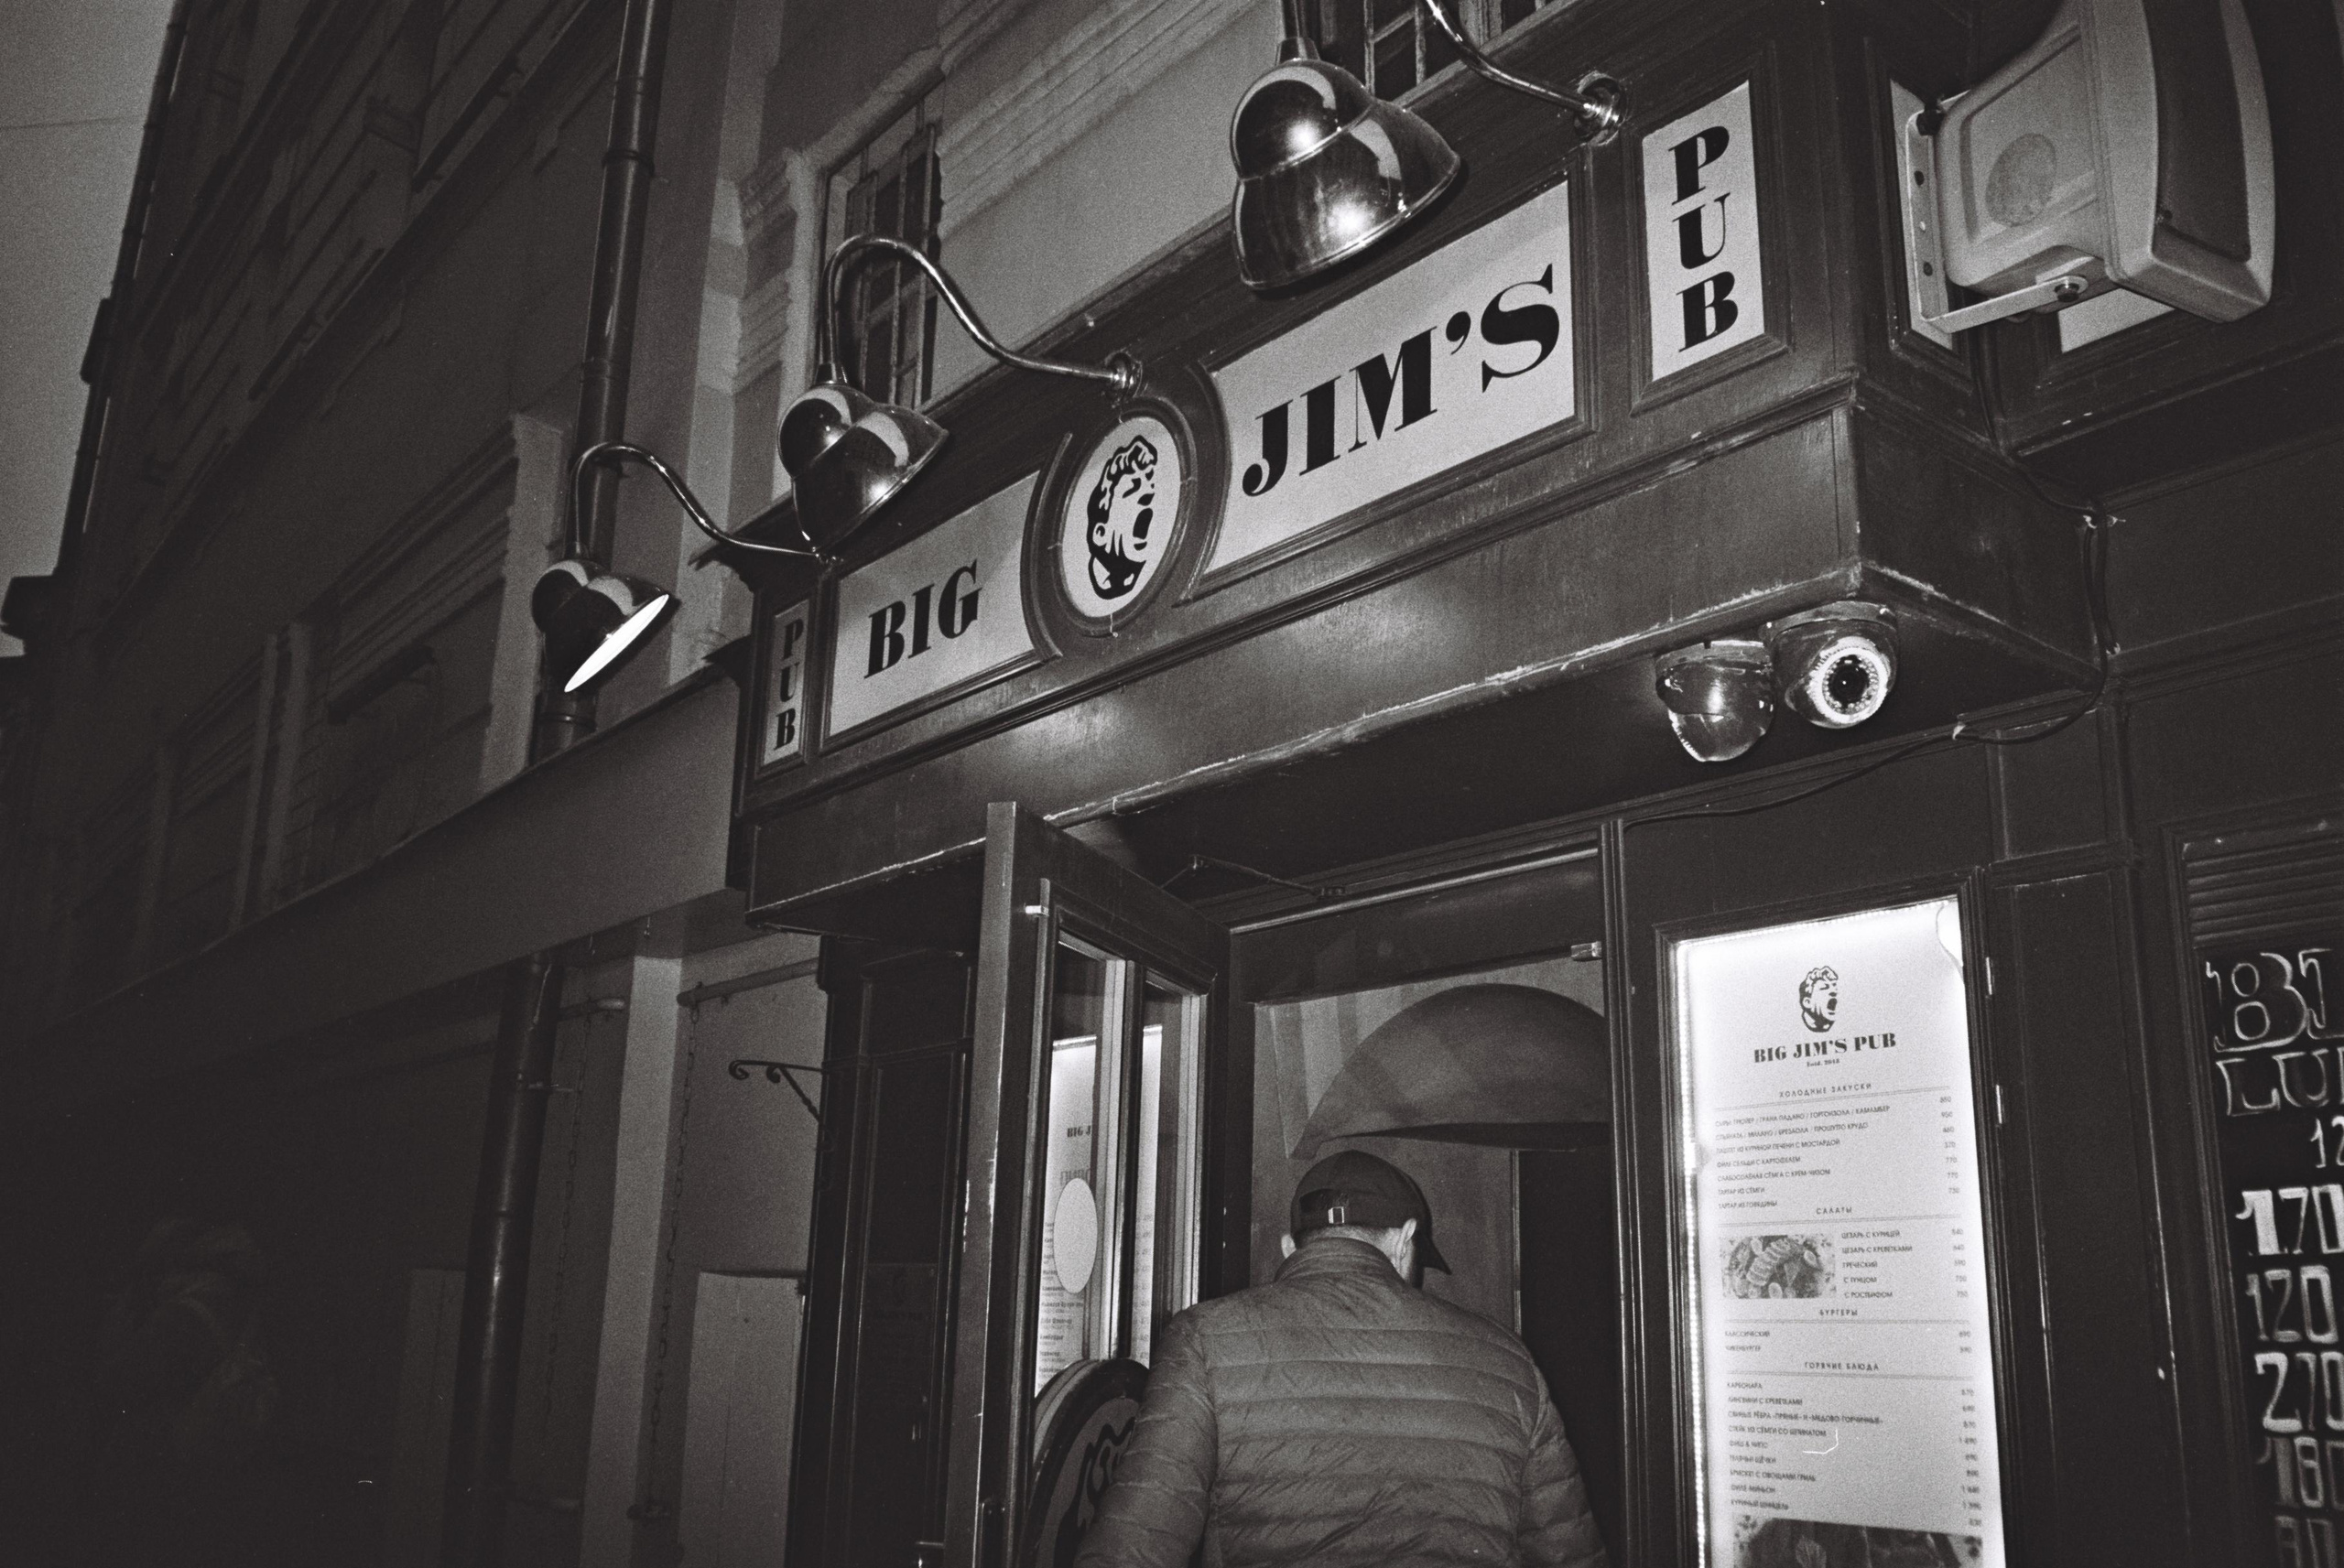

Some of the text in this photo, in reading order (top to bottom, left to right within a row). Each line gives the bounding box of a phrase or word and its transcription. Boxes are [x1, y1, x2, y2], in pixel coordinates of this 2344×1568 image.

[1667, 125, 1739, 353] PUB
[863, 264, 1560, 678] BIG JIM'S
[774, 618, 804, 751] PUB
[1753, 1033, 1896, 1064] BIG JIM'S PUB
[1779, 1083, 1872, 1098] ХОЛОДНЫЕ ЗАКУСКИ
[1067, 1126, 1084, 1138] BIG
[1816, 1206, 1853, 1215] САЛАТЫ
[2235, 1184, 2344, 1256] 170
[1818, 1308, 1859, 1317] БУРГЕРЫ
[2245, 1265, 2339, 1344] 120
[1805, 1361, 1880, 1372] ГОРЯЧИЕ БЛЮДА
